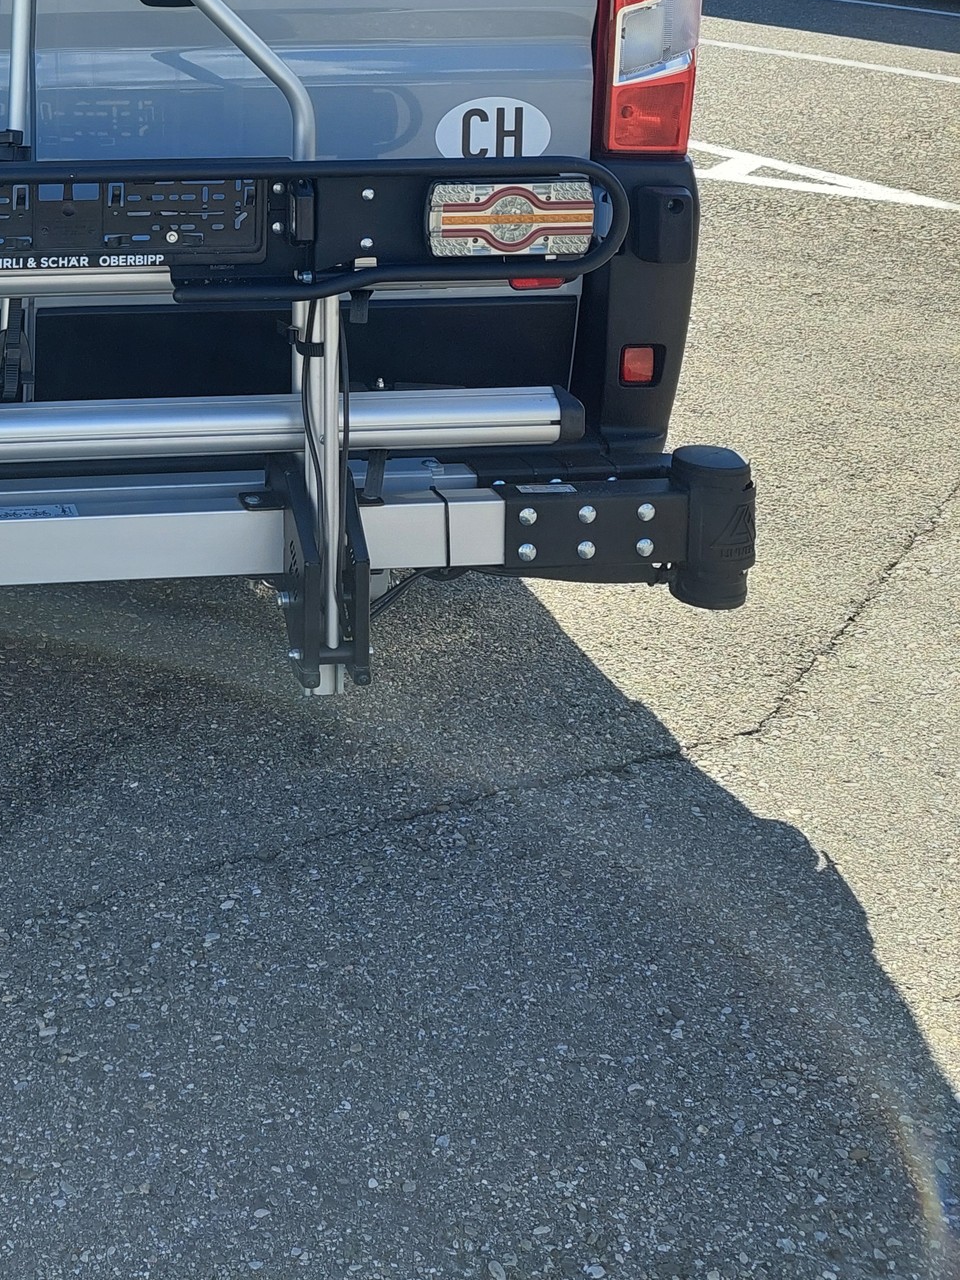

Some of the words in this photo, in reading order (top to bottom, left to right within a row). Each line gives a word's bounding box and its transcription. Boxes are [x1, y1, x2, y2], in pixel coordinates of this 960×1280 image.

[461, 107, 524, 158] CH
[26, 257, 37, 269] &
[40, 254, 89, 268] SCHÄR
[98, 254, 165, 266] OBERBIPP
